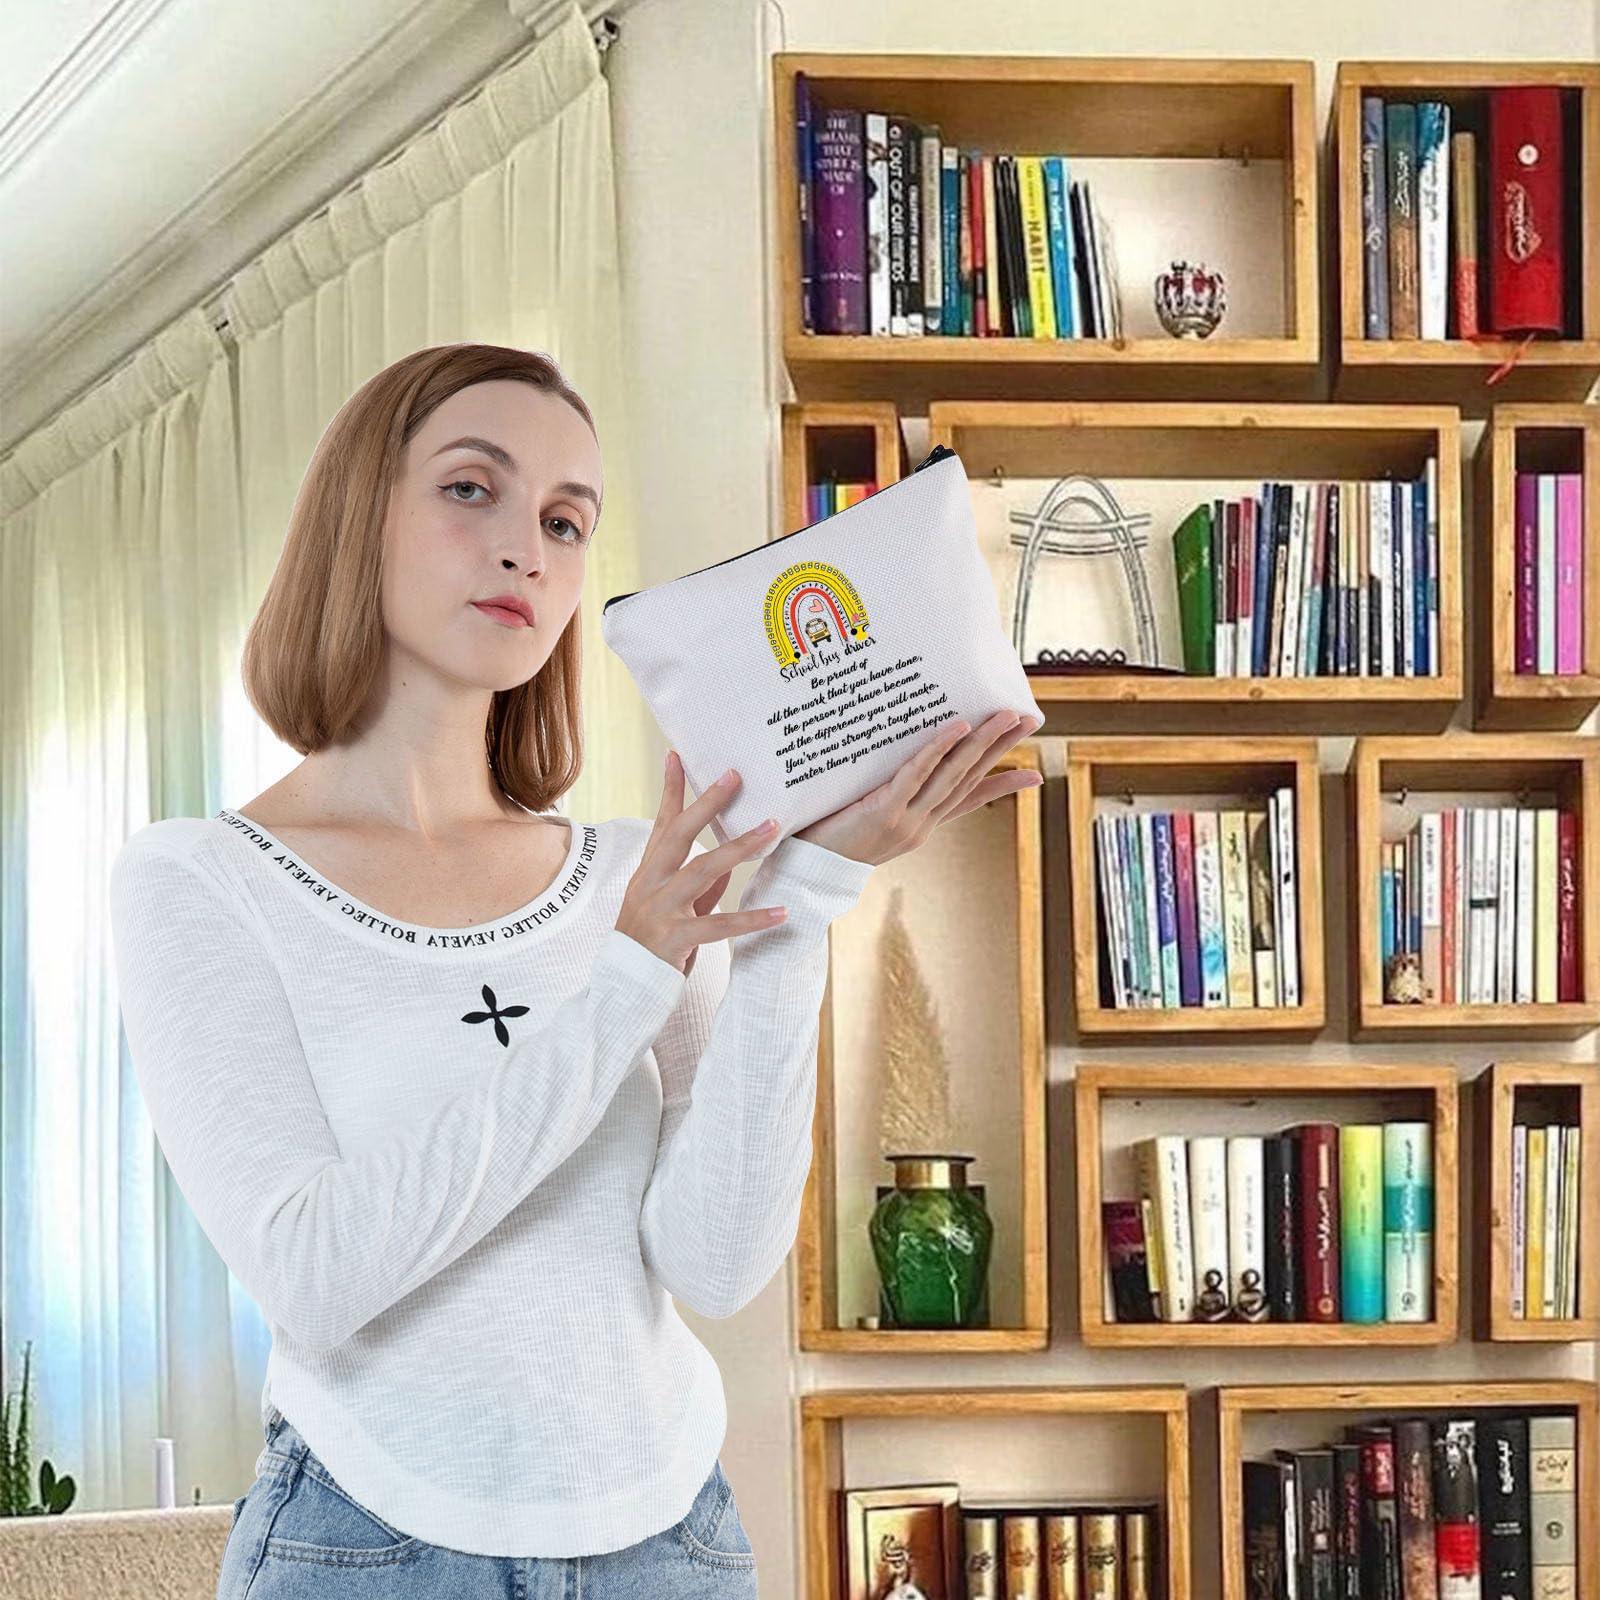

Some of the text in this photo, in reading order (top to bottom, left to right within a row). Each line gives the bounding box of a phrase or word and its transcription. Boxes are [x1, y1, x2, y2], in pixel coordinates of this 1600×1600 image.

[889, 147, 902, 178] OUT
[890, 179, 902, 202] OF
[891, 202, 904, 235] OUR
[1027, 221, 1046, 273] HABIT
[780, 636, 877, 682] School bus driver
[811, 658, 868, 690] Be proud of
[767, 655, 922, 726] all the work that you have done,
[784, 672, 921, 736] the person you have become
[776, 683, 939, 757] and the difference you will make.
[785, 692, 948, 773] You're now stronger, tougher and
[785, 710, 958, 789] smarter than you ever were before.
